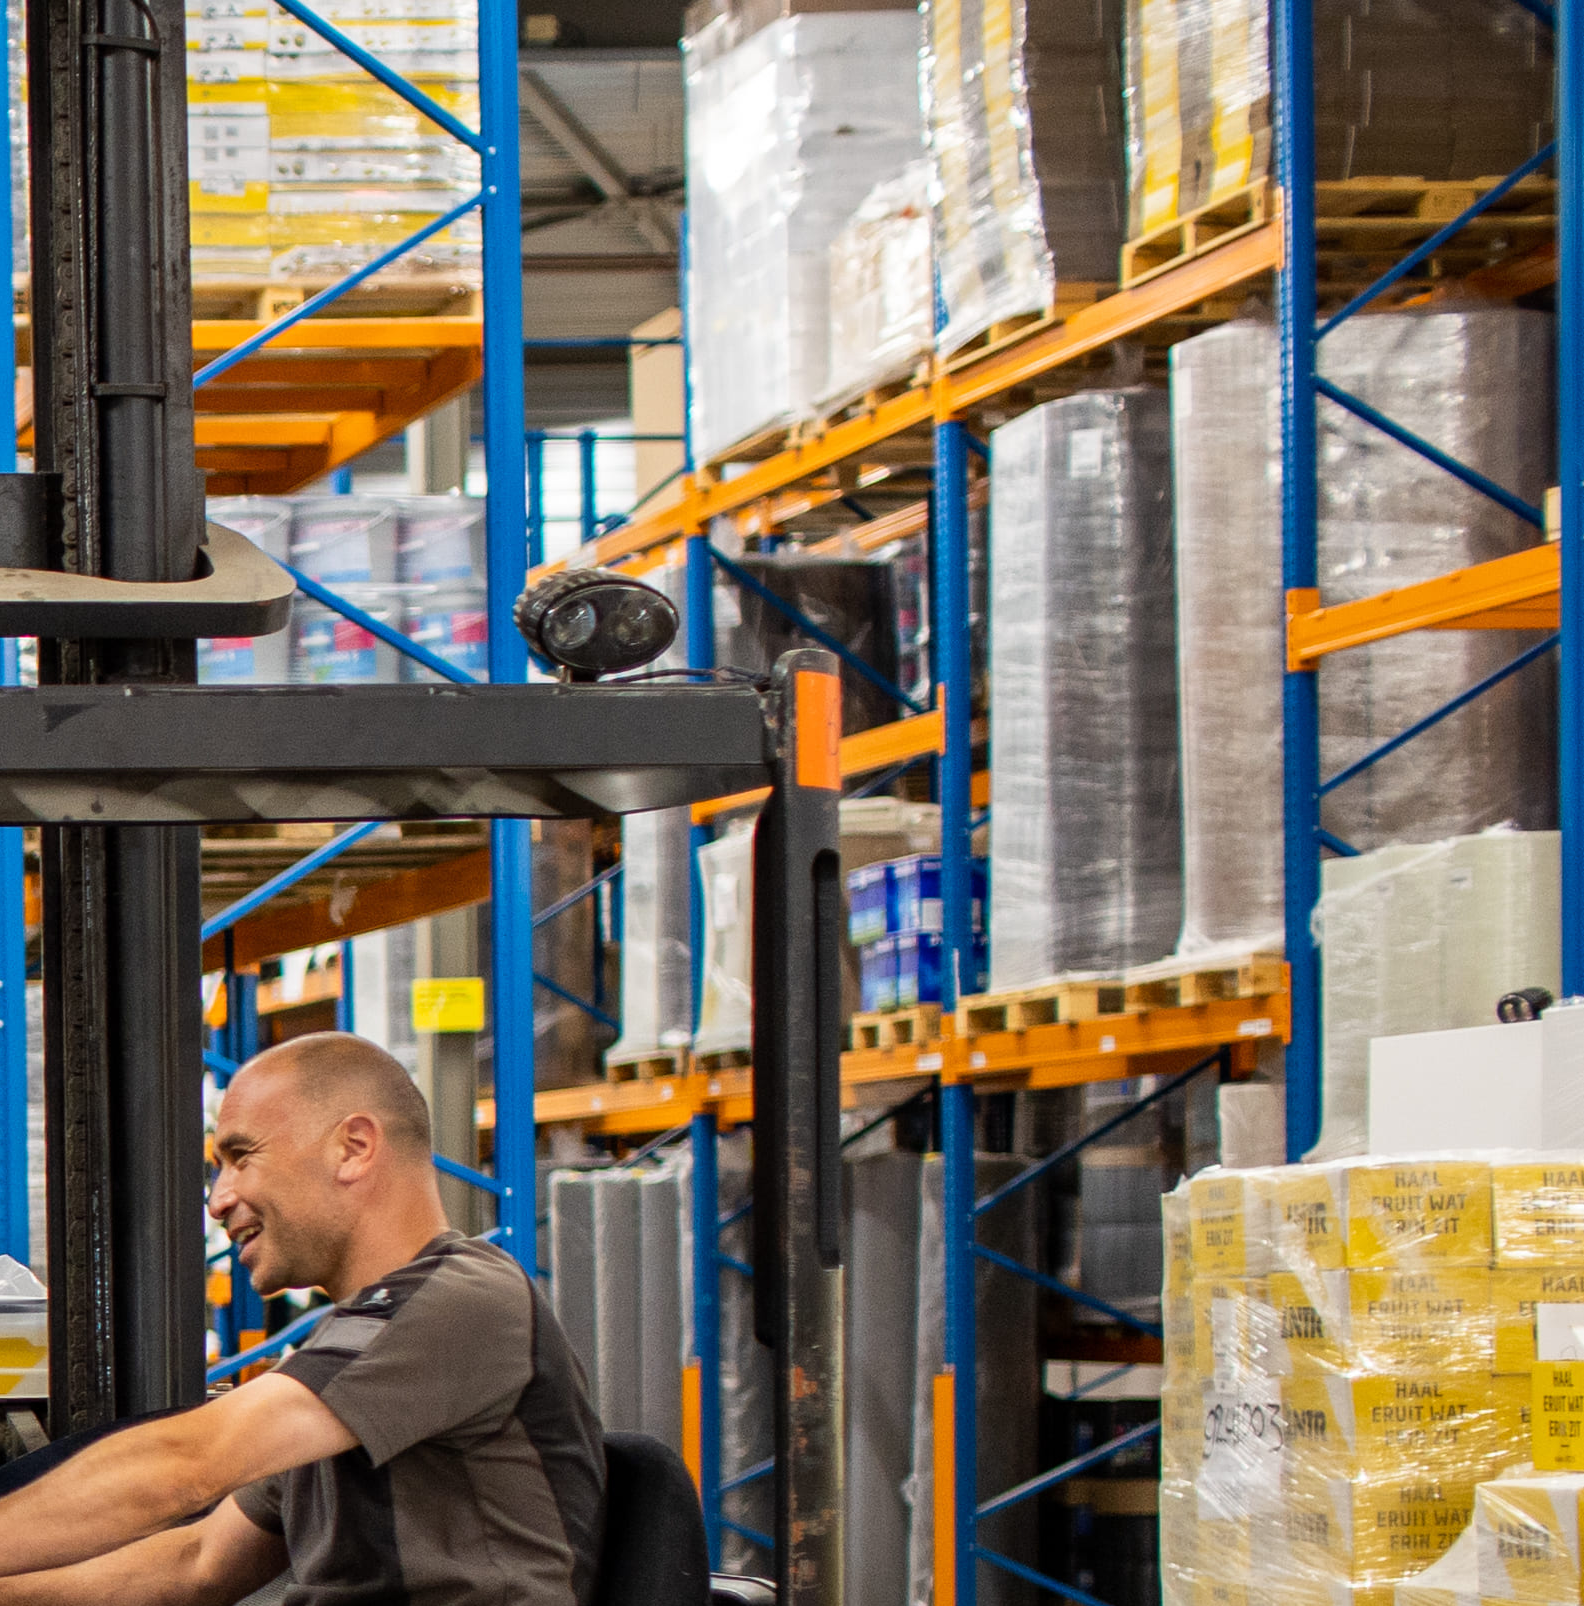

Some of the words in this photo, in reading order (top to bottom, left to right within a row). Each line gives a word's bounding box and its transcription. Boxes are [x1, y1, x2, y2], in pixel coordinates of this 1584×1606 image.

[1395, 1171, 1443, 1188] HAAL
[1429, 1193, 1469, 1211] WAT
[1433, 1217, 1461, 1235] ZIT
[1396, 1382, 1444, 1399] HAAL
[1372, 1406, 1424, 1424] ERUIT
[1400, 1485, 1446, 1503] HAAL
[1377, 1510, 1427, 1527] ERUIT
[1433, 1508, 1472, 1526] WAT
[1390, 1533, 1431, 1551] ERIN
